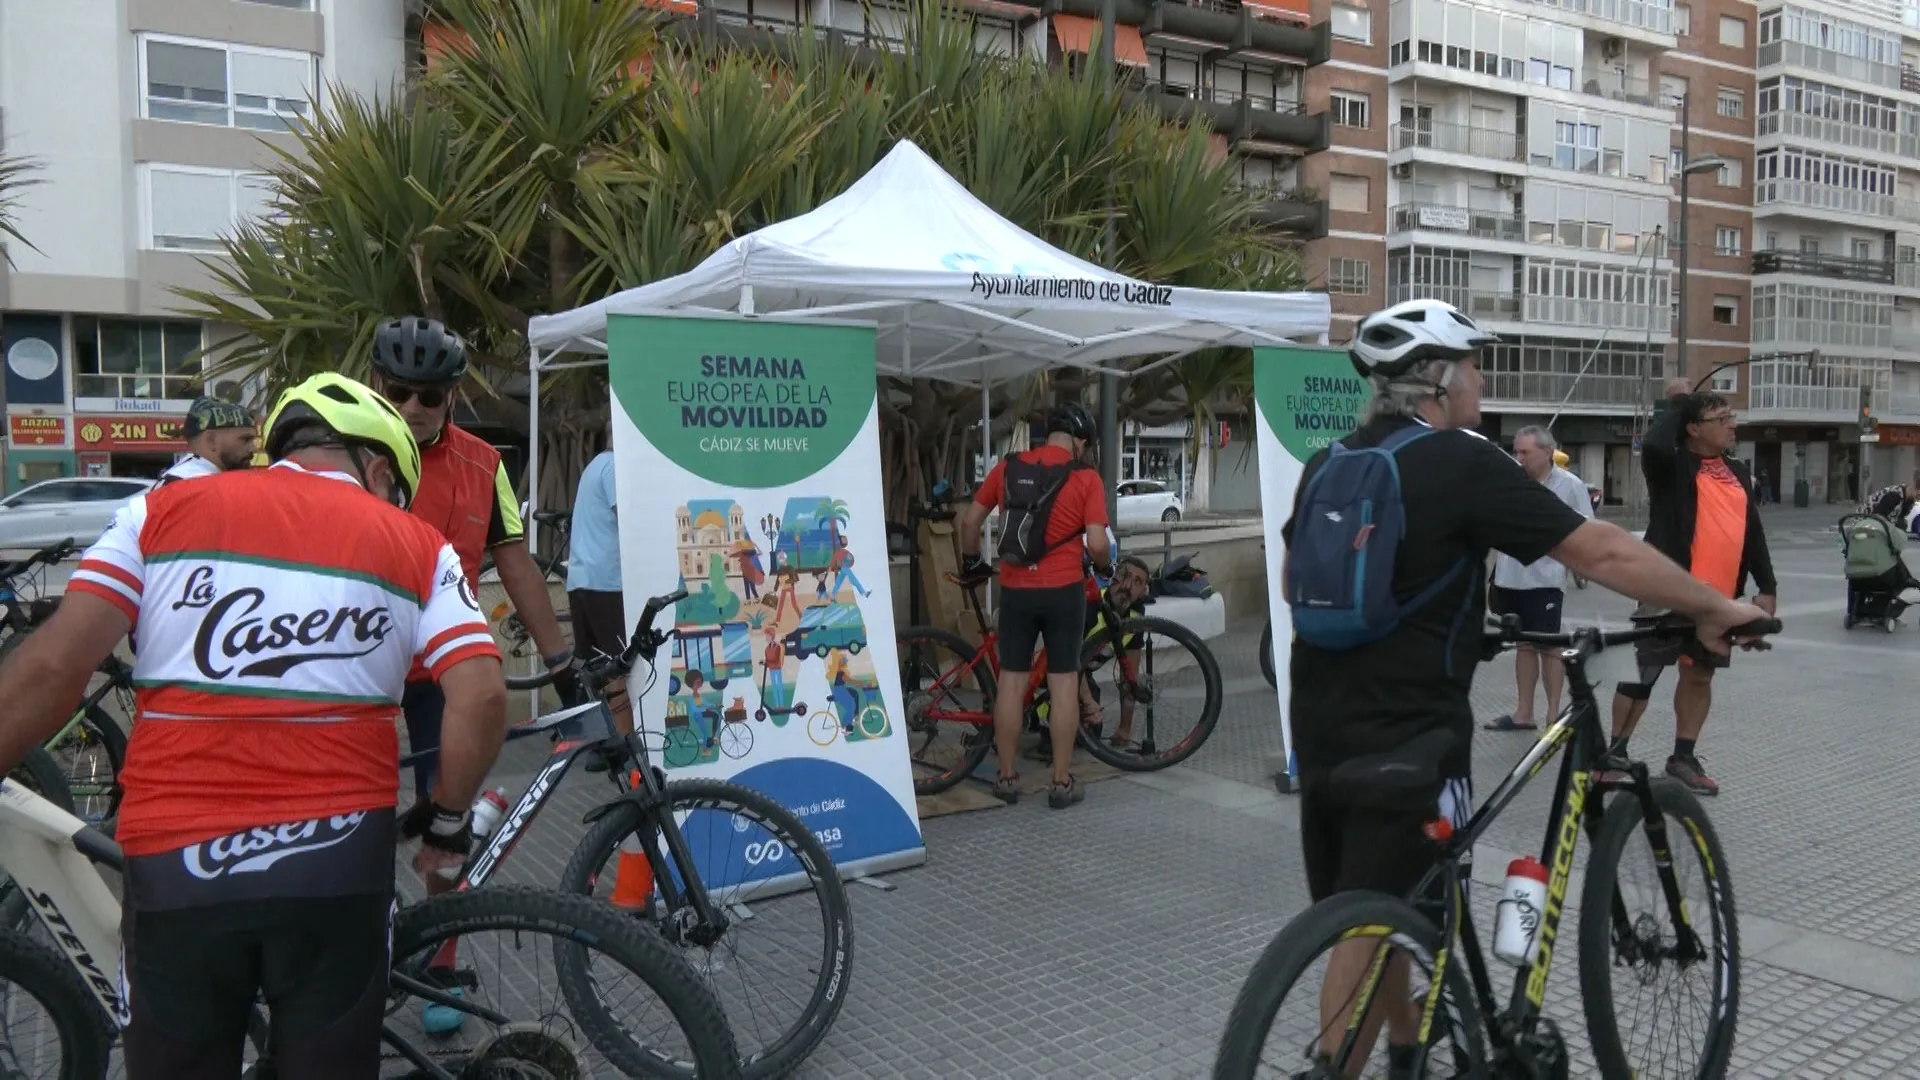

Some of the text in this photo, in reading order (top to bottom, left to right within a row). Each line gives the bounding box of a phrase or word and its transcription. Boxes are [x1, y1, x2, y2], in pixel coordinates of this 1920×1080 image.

[970, 271, 1095, 300] Ayuntamiento
[1100, 281, 1120, 302] de
[701, 355, 806, 379] SEMANA
[668, 381, 832, 405] EUROPEA DE LA
[1304, 376, 1362, 394] SEMANA
[1287, 395, 1342, 413] EUROPEA
[681, 405, 827, 429] MOVILIDAD
[1294, 413, 1357, 430] MOVILID
[110, 422, 147, 439] XIN
[700, 435, 809, 452] CÁDIZ SE MUEVE
[172, 565, 217, 611] La
[194, 587, 393, 680] Casera
[27, 886, 119, 1014] STEVEN
